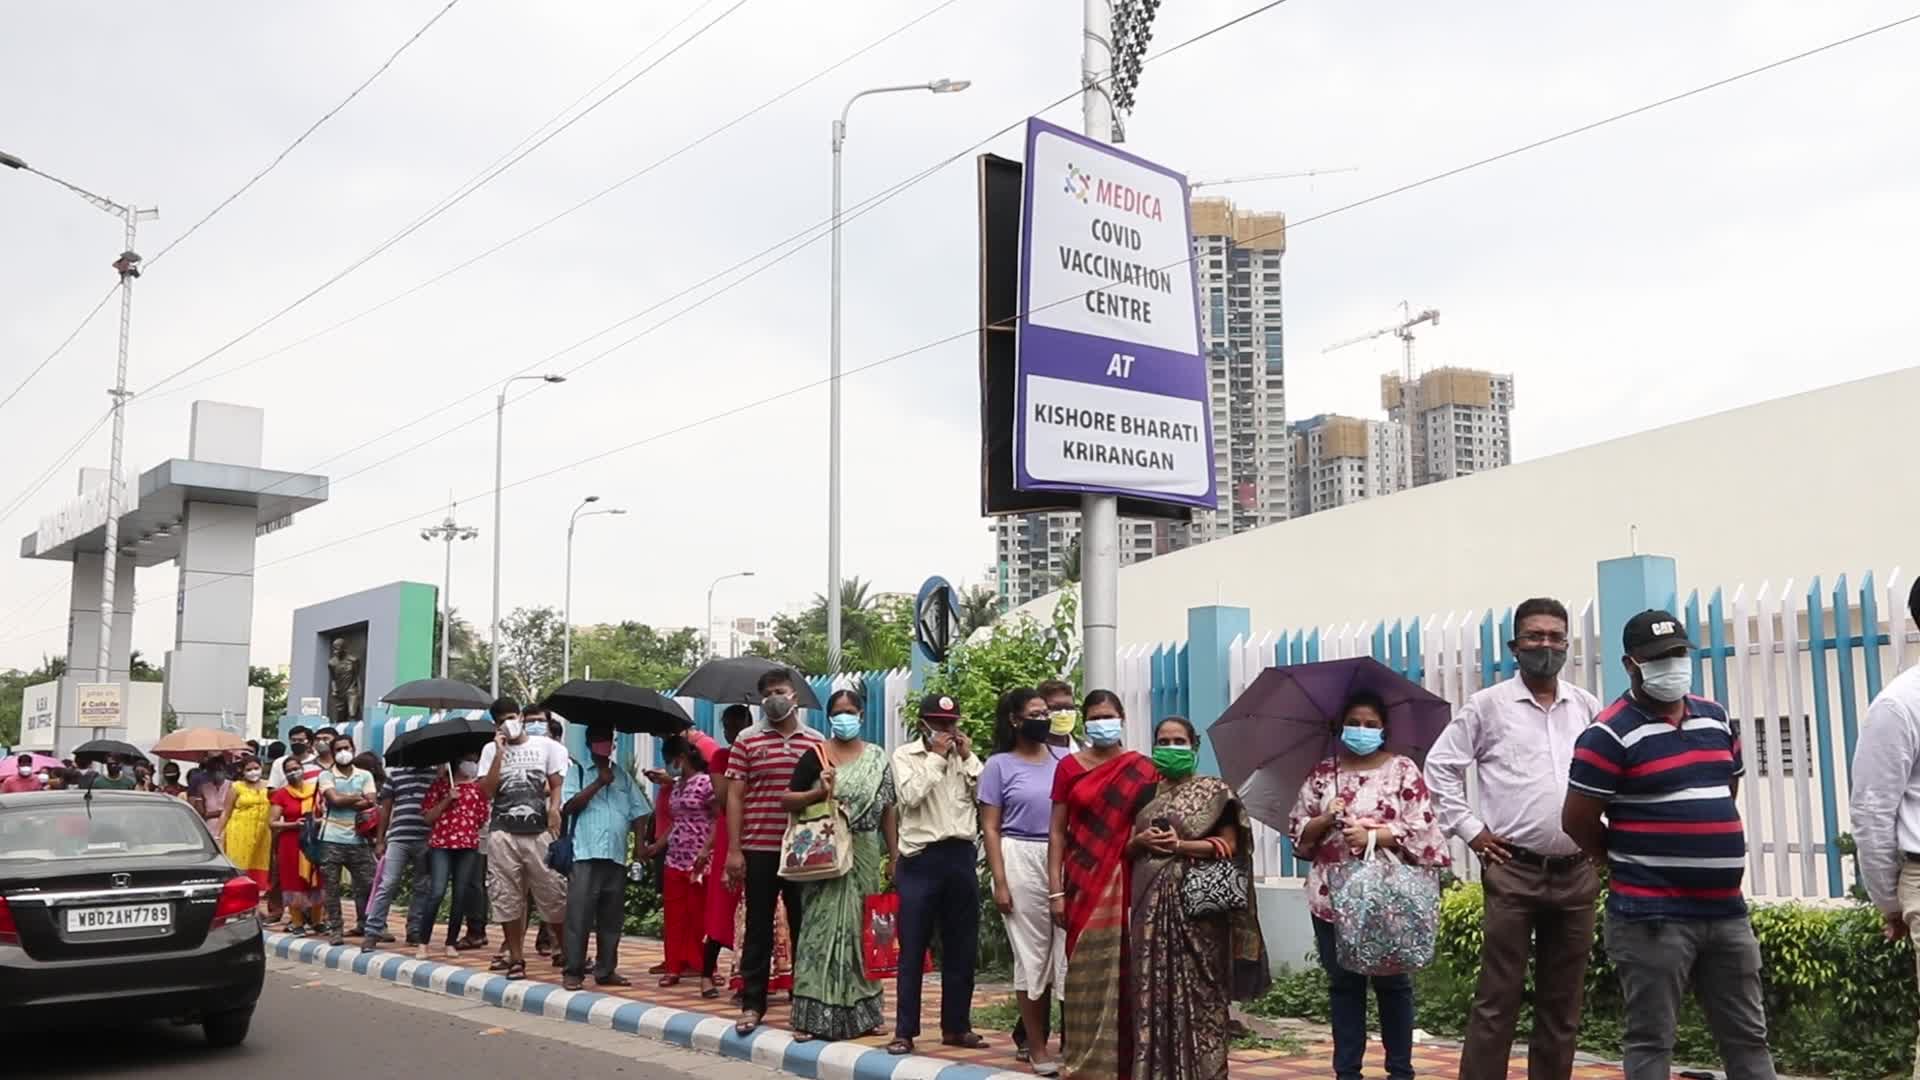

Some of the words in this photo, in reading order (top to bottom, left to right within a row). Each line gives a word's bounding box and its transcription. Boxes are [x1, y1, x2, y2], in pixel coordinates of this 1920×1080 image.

[1096, 178, 1162, 222] MEDICA
[1091, 218, 1142, 251] COVID
[1059, 245, 1171, 294] VACCINATION
[1085, 289, 1151, 323] CENTRE
[1106, 353, 1135, 379] AT
[1034, 403, 1116, 432] KISHORE
[1120, 416, 1199, 442] BHARATI
[1063, 440, 1174, 470] KRIRANGAN
[1651, 621, 1676, 636] CAT
[79, 907, 168, 927] WB02AH7789
